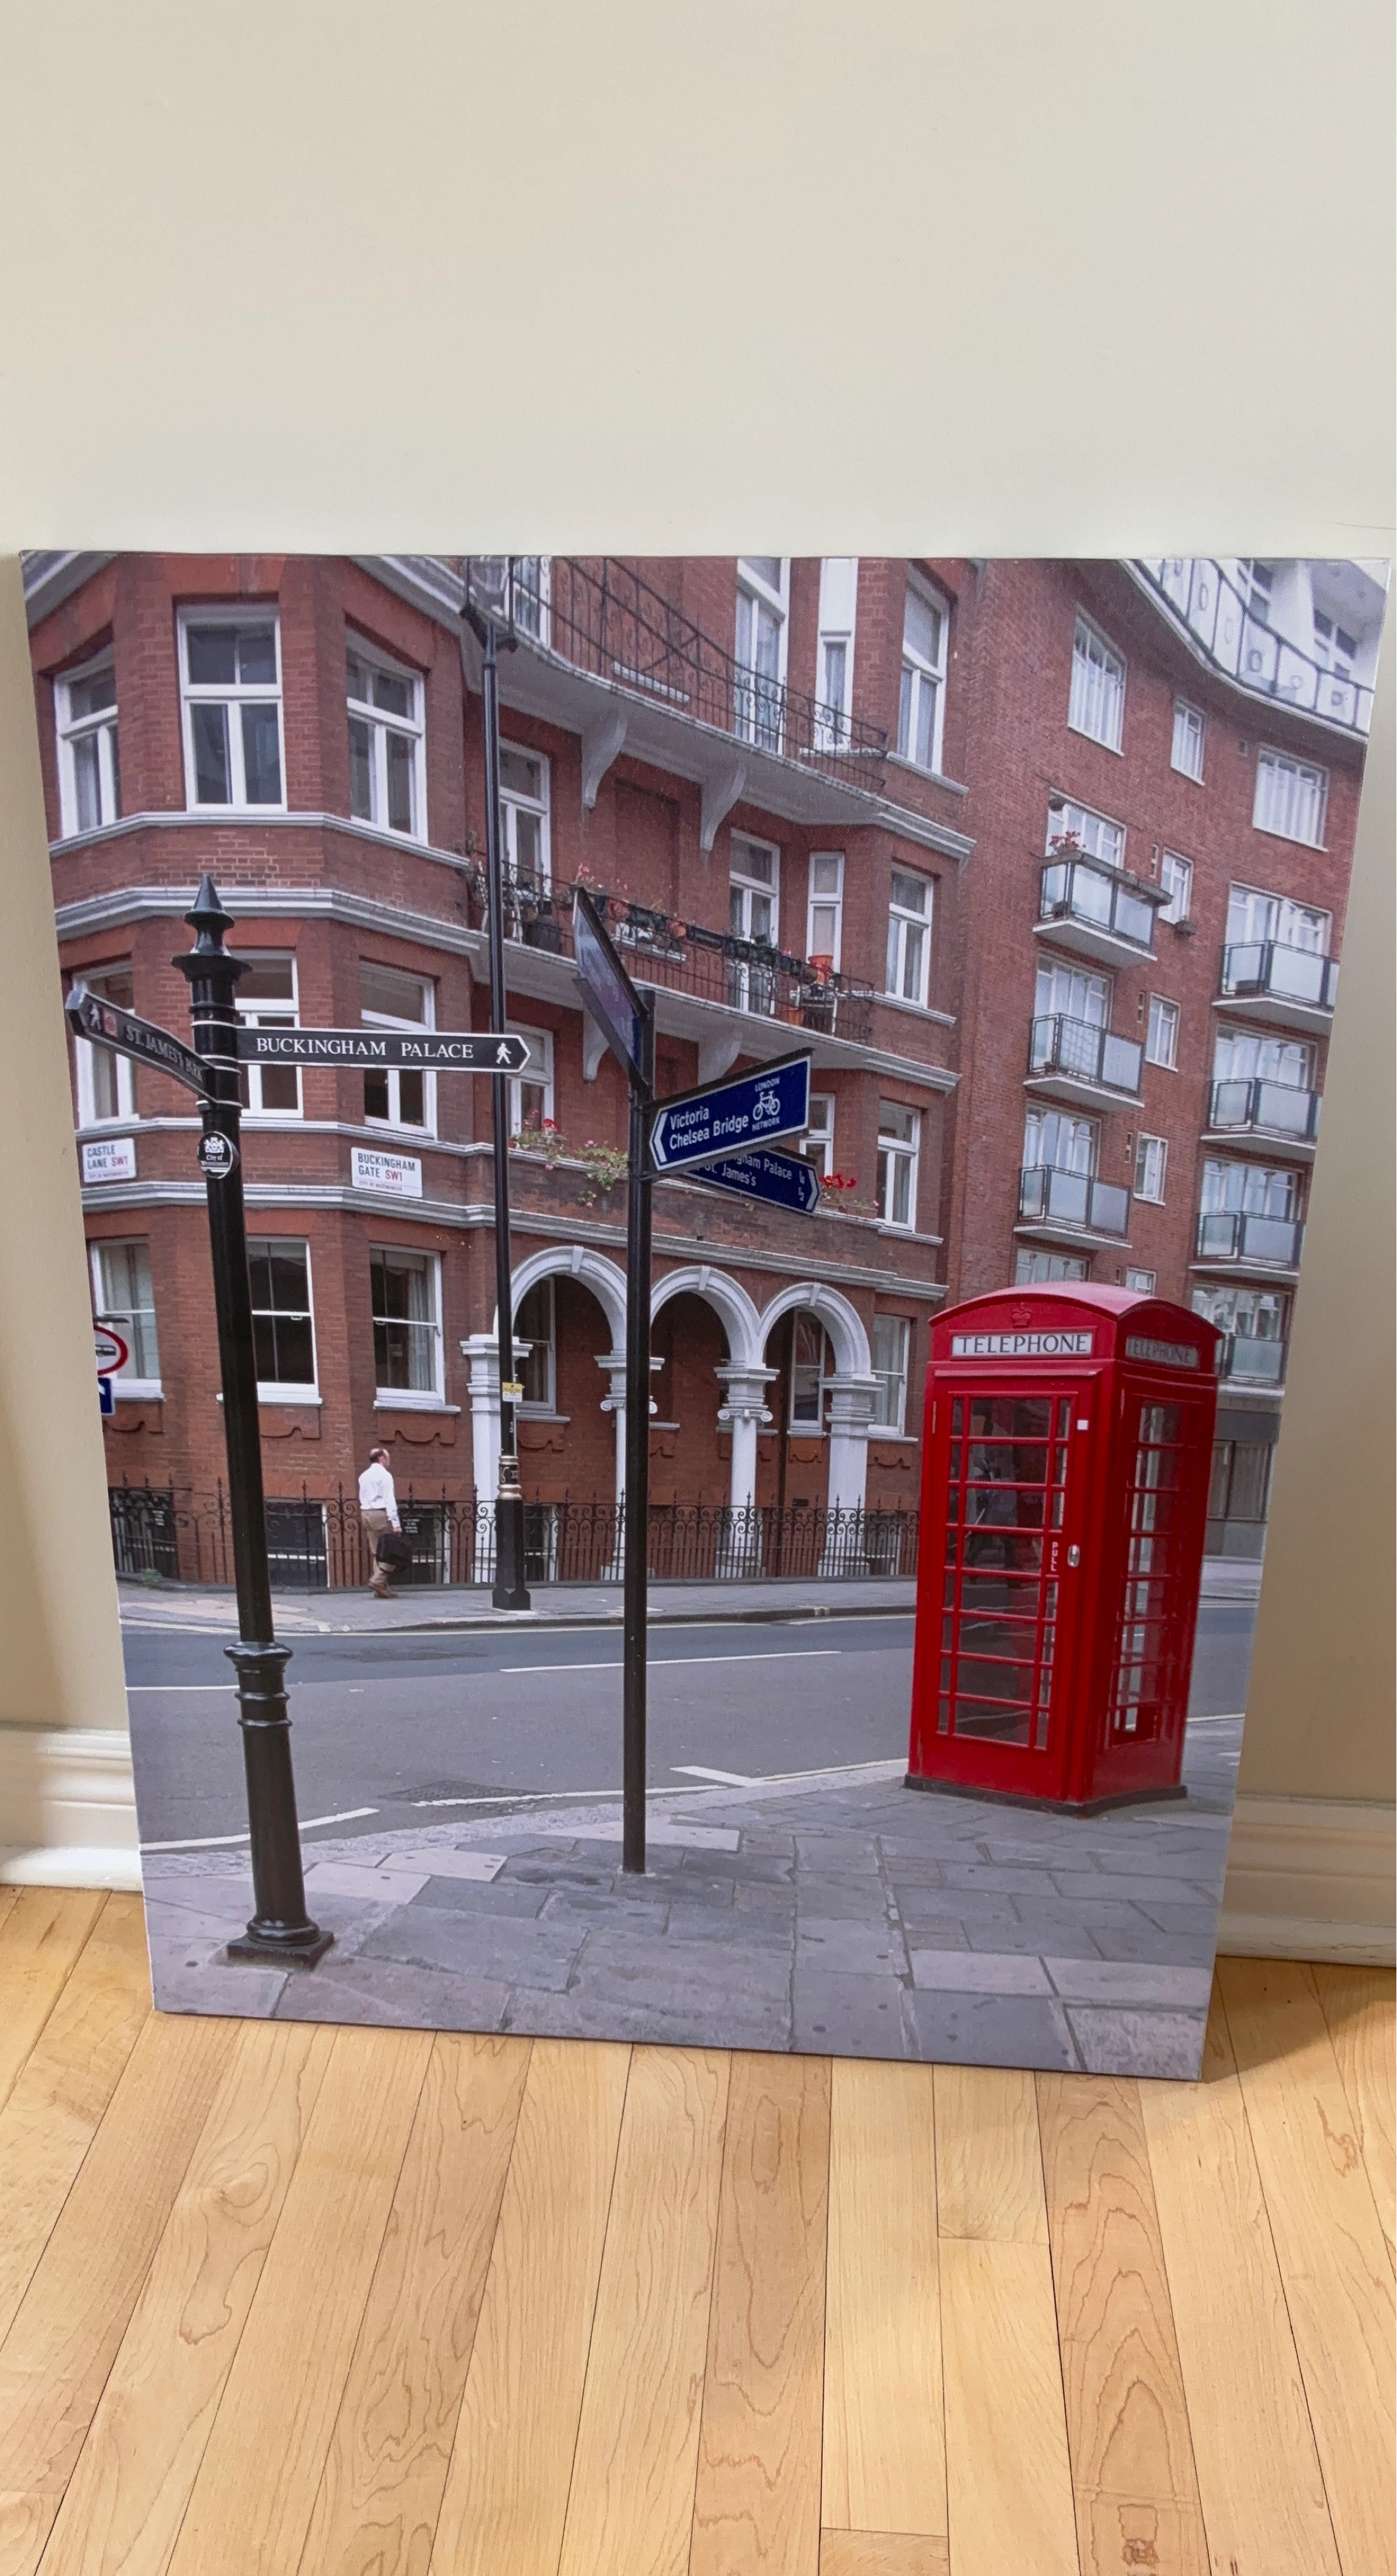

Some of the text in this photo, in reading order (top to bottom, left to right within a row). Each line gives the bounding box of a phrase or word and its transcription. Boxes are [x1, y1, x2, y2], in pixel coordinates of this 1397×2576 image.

[256, 1038, 473, 1058] BUCKINGHAM PALACE
[755, 1077, 780, 1092] LONDON
[670, 1106, 710, 1131] Victoria
[752, 1116, 780, 1132] NETWORK
[670, 1115, 749, 1150] Chelsea Bridge
[87, 1144, 116, 1158] CASTLE
[87, 1156, 128, 1169] LANE SW1
[358, 1153, 416, 1172] BUCKINGHAM
[764, 1157, 792, 1180] Palace
[358, 1165, 402, 1181] GATE SW1
[721, 1163, 757, 1187] James's
[959, 1335, 1089, 1353] TELEPHONE
[1127, 1338, 1192, 1364] TELEPHONE
